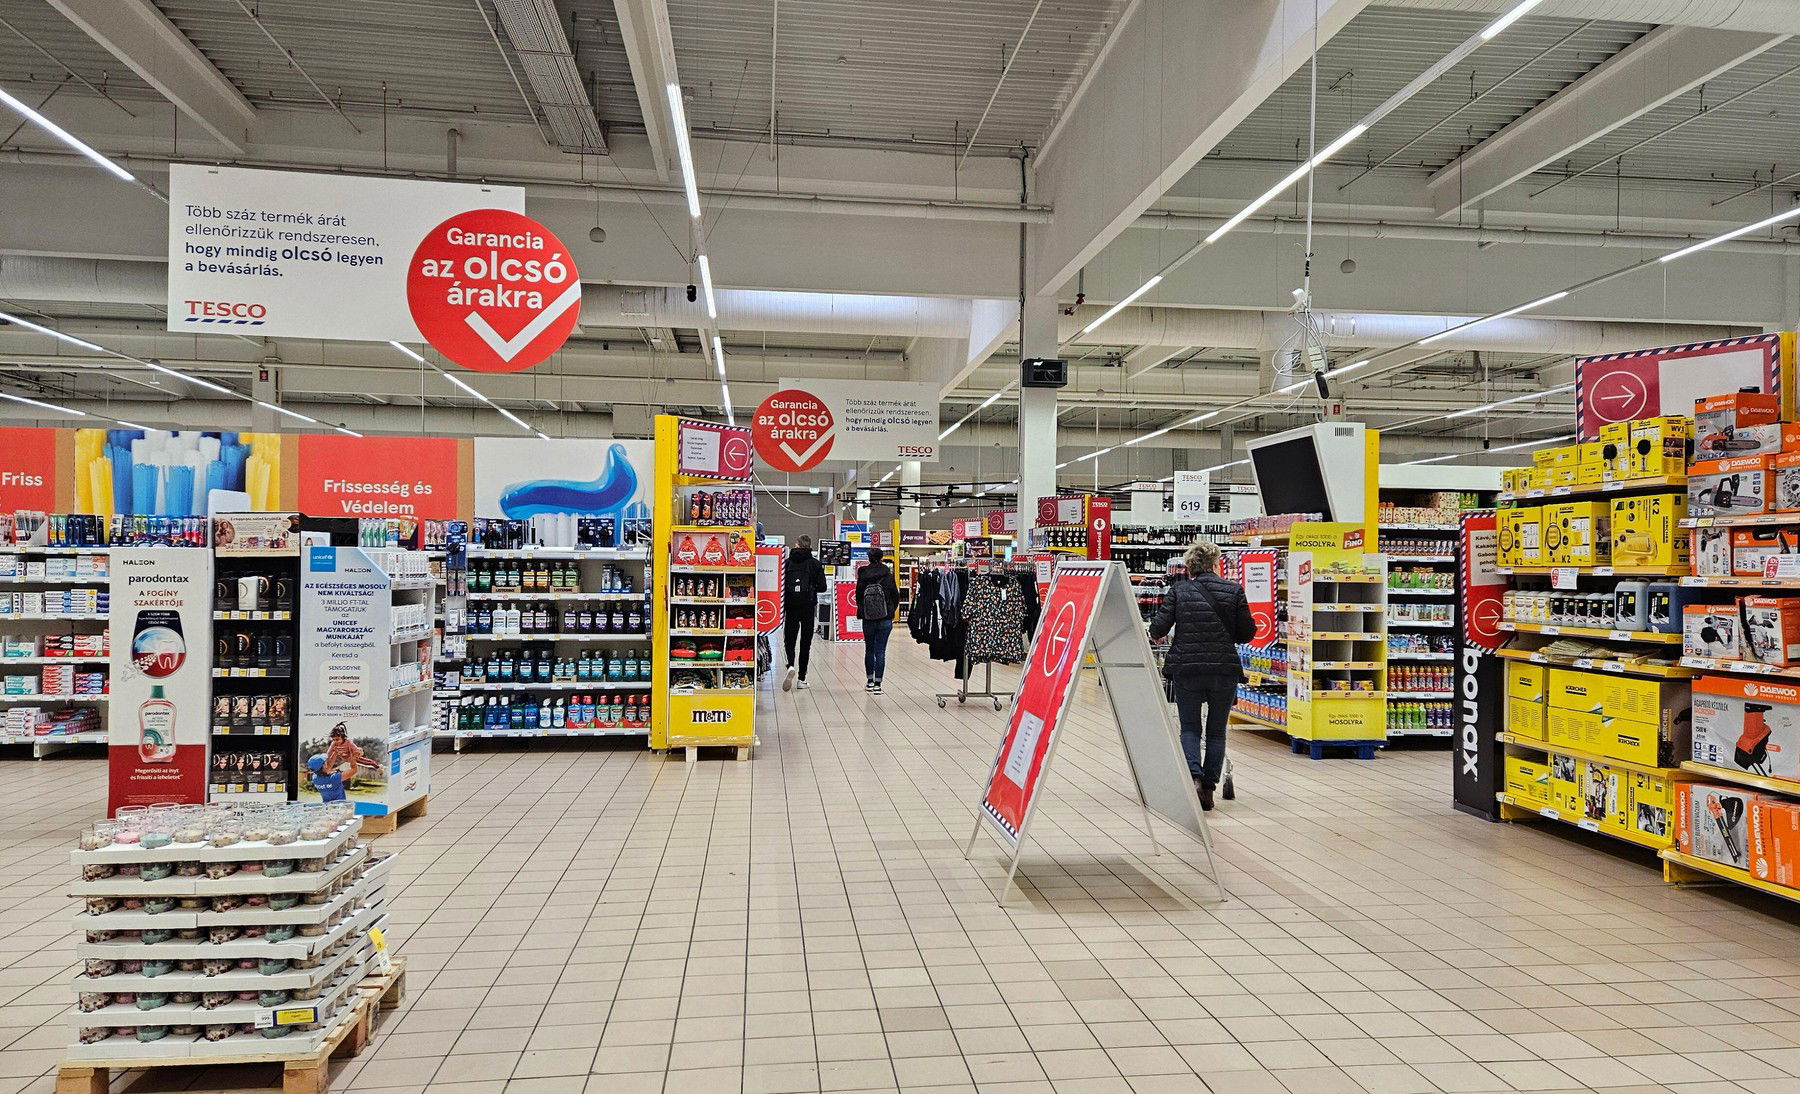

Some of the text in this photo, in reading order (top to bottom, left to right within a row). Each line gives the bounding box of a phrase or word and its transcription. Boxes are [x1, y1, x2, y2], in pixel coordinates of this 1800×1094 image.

[186, 205, 346, 227] Több száz termék árát
[186, 222, 274, 241] ellenőrizzük
[447, 227, 545, 250] Garancia
[186, 243, 384, 267] hogy mindig olcsó legyen
[186, 260, 284, 278] a bevásárlás.
[423, 251, 568, 284] az olcsó
[447, 282, 544, 309] árakra
[185, 301, 267, 320] TESCO
[770, 399, 817, 410] Garancia
[863, 399, 877, 407] száz
[879, 399, 902, 407] termék
[845, 407, 885, 415] ellenőrizzük
[759, 411, 830, 427] az olcsó
[845, 416, 933, 427] hogy mindig olcsó legyen
[770, 426, 817, 440] árakra
[851, 425, 889, 433] bevásárlás.
[897, 446, 933, 454] TESCO
[1731, 457, 1761, 468] DAEWOO
[0, 471, 43, 486] Friss
[323, 479, 432, 499] Frissesség és
[340, 499, 415, 516] Védelem
[1180, 500, 1201, 511] 619
[1295, 540, 1337, 549] MOSOLYRA
[1343, 538, 1363, 549] FINO
[128, 574, 190, 586] parodontax
[315, 582, 357, 591] EGÉSZSÉGES
[359, 583, 387, 591] MOSOLY
[146, 588, 179, 598] FOGÍNY
[335, 590, 374, 598] KIVÁLTSÁG!
[133, 598, 184, 608] SZAKÉRTŐJE
[325, 632, 365, 641] MUNKÁJÁT
[320, 641, 343, 650] befolyt
[1759, 685, 1798, 697] DAEWOO
[692, 709, 732, 723] m&m's
[1462, 647, 1483, 778] bonax
[1753, 804, 1764, 856] DAEWOO
